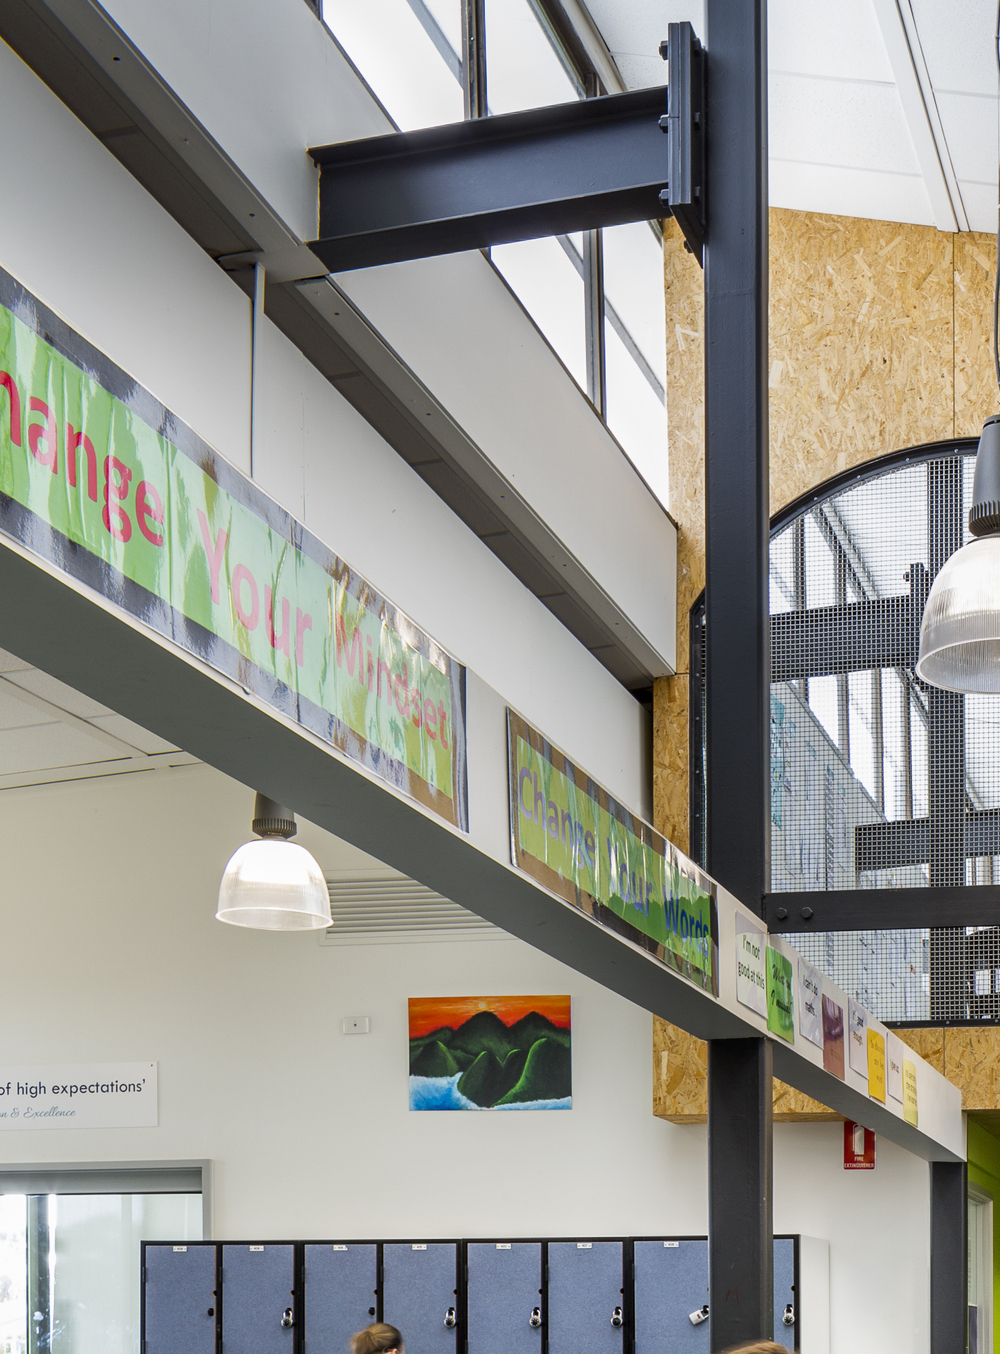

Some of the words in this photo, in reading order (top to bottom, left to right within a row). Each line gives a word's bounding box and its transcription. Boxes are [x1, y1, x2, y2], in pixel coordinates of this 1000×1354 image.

[197, 508, 313, 667] Your
[335, 611, 450, 749] Mindset
[518, 766, 596, 870] Change
[663, 884, 709, 958] Words
[751, 942, 760, 960] not
[738, 961, 750, 980] good
[750, 969, 756, 984] at
[756, 970, 765, 989] this
[17, 1081, 47, 1098] high
[10, 1107, 20, 1118] &
[23, 1106, 76, 1120] Excellence
